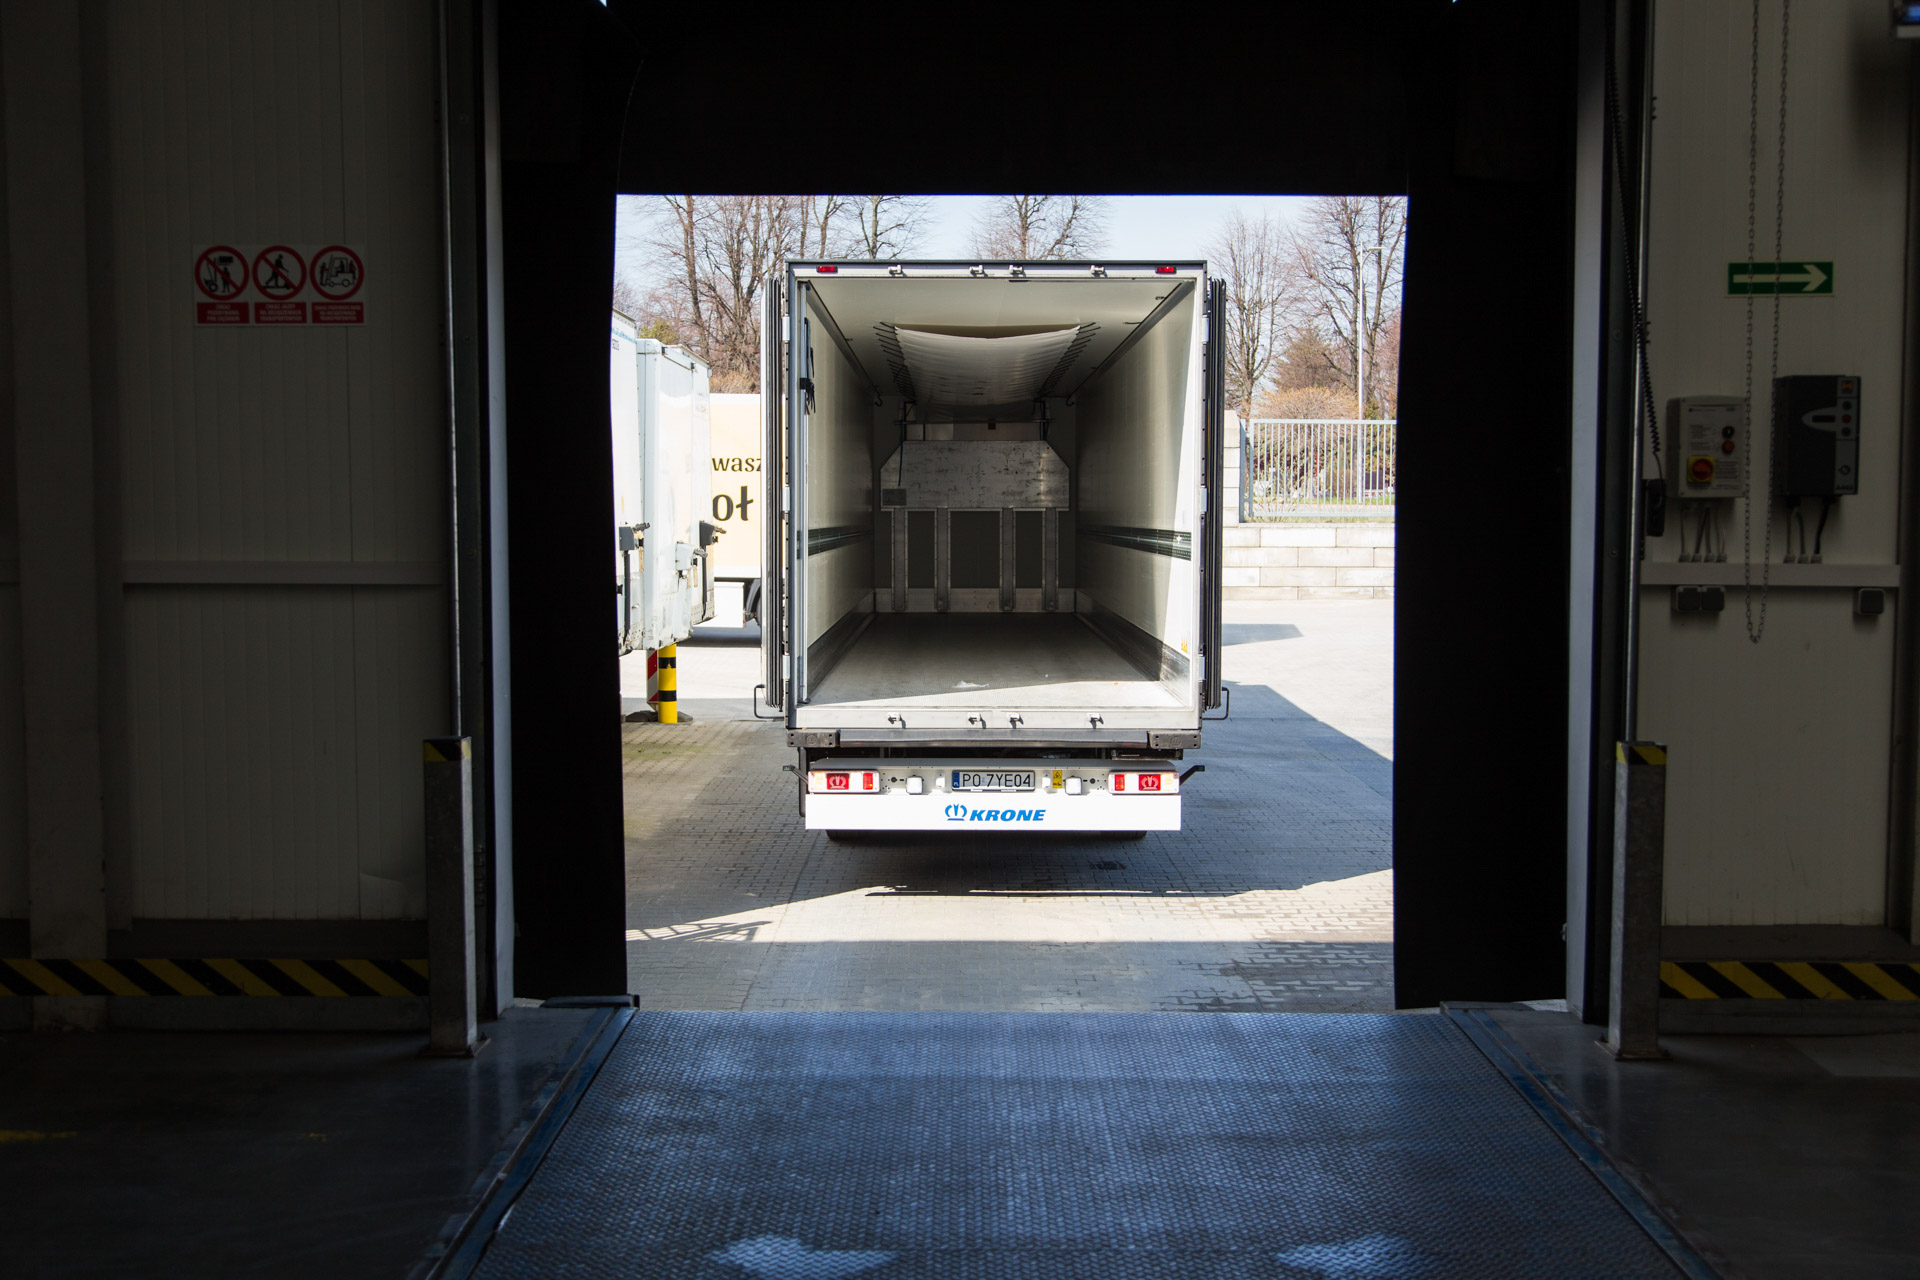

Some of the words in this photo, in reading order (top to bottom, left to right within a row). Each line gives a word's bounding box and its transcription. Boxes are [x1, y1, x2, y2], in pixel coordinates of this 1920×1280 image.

[962, 773, 981, 788] PO
[986, 773, 1031, 788] 7YE04
[969, 809, 1046, 822] KRONE
